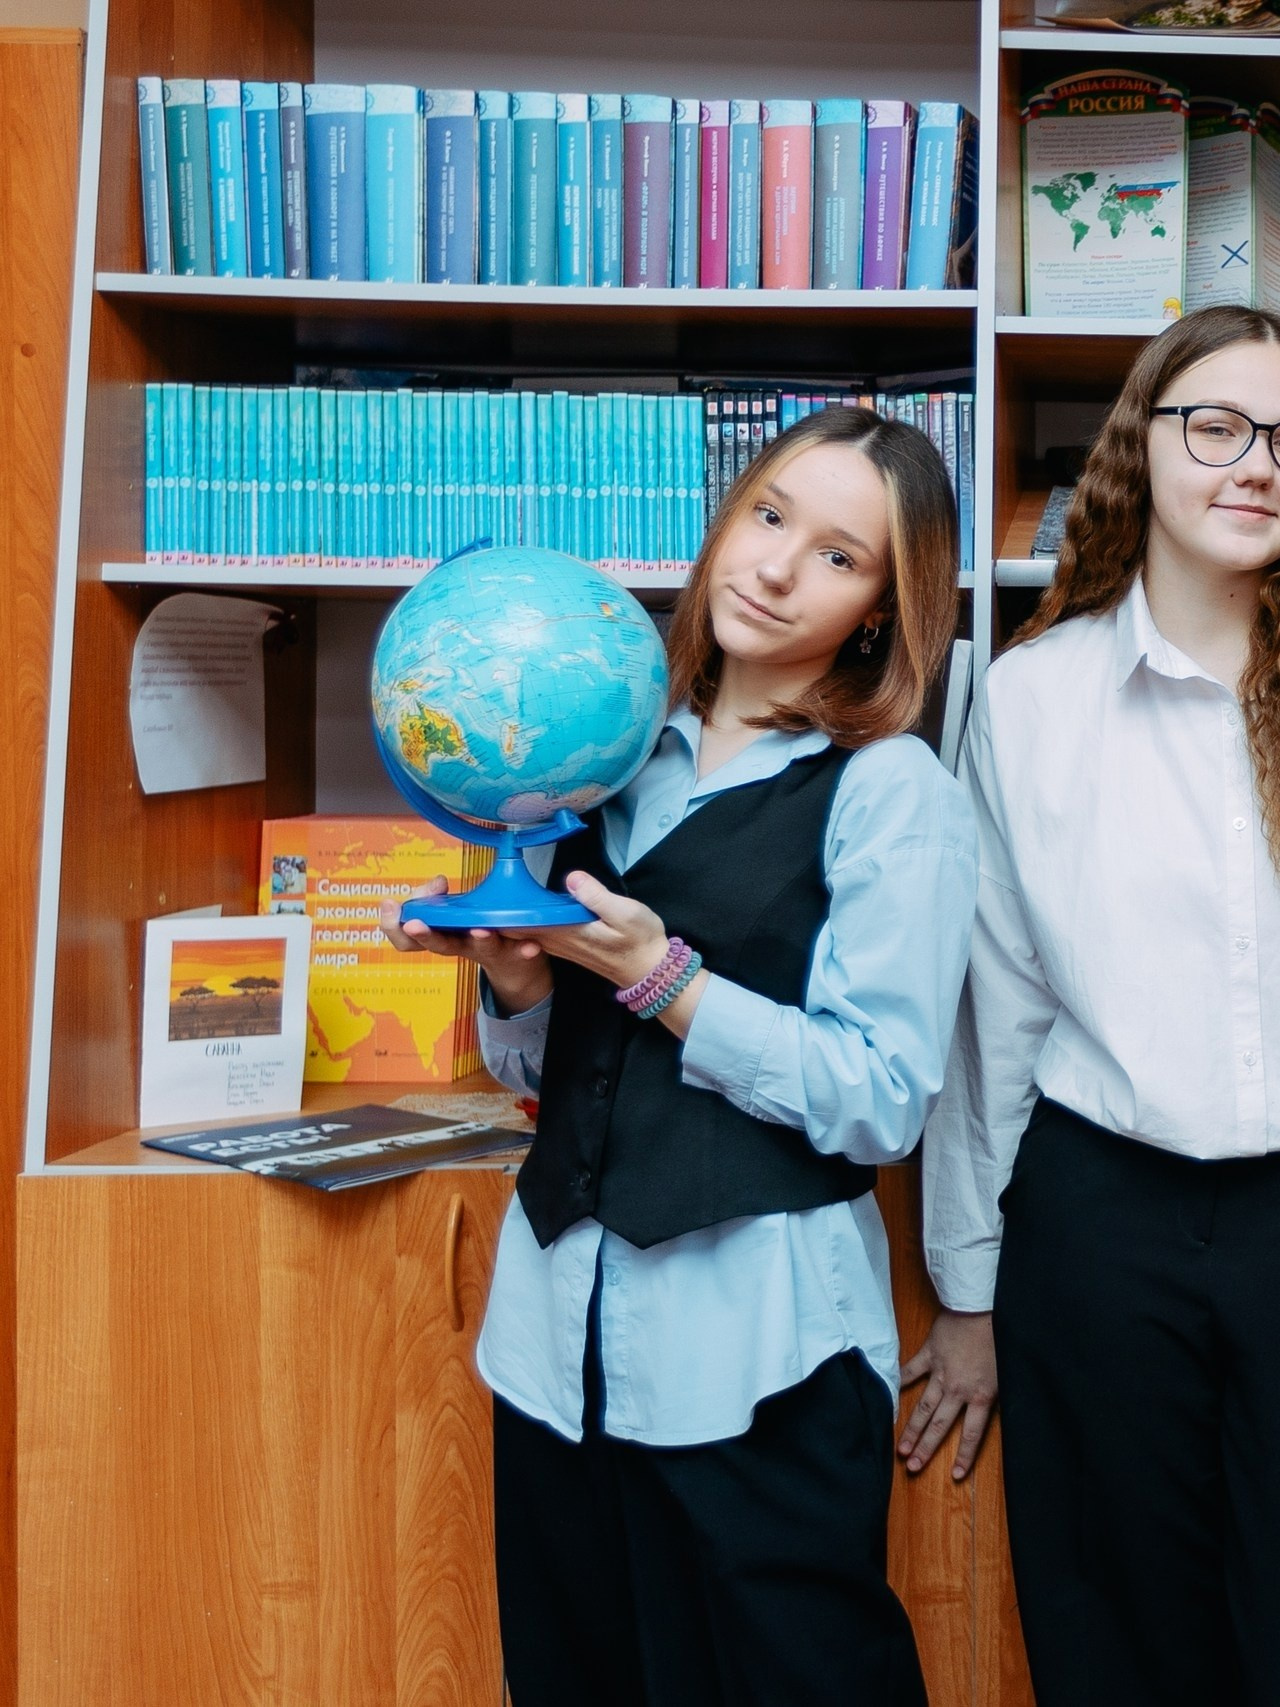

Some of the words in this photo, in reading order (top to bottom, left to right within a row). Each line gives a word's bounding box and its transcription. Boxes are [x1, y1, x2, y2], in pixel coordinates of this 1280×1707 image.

[1068, 95, 1145, 113] РОССИЯ
[878, 174, 887, 221] ПУТЕШЕСТВИЯ
[877, 235, 885, 261] АФРИКЕ
[316, 905, 382, 920] эконом
[314, 926, 388, 948] географ
[314, 952, 360, 969] мира
[313, 986, 385, 996] СПРАВОЧНОЕ
[390, 986, 442, 995] ПОСОБИЕ
[188, 1123, 353, 1153] РАБОТА
